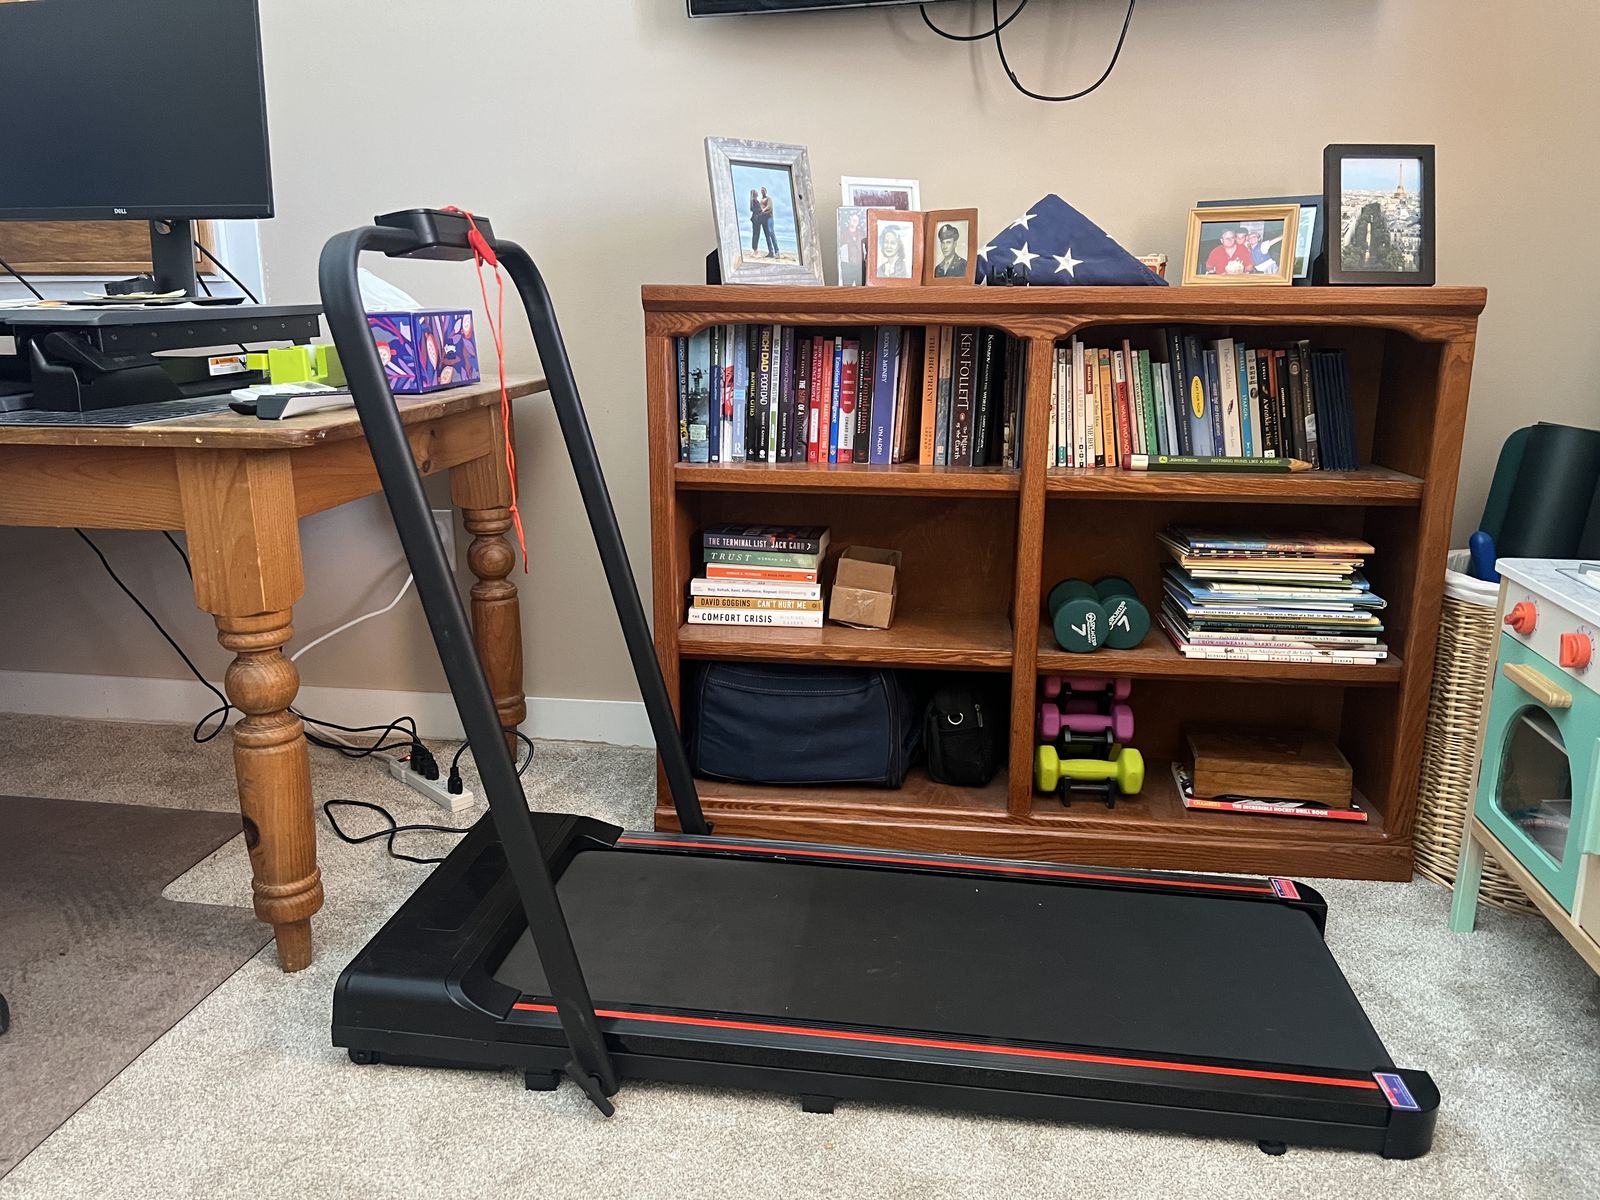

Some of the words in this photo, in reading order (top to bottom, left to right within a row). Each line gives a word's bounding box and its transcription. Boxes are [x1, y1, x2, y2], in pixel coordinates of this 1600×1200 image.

[961, 333, 973, 356] KEN
[761, 352, 769, 372] DAD
[760, 374, 768, 391] POOR
[958, 360, 971, 410] FOLLETT
[760, 392, 768, 405] DAD
[861, 378, 871, 434] Foundations
[1103, 384, 1111, 411] Becoming
[1264, 404, 1272, 426] Wrinkle
[708, 537, 720, 545] THE
[723, 538, 752, 547] TERMINAL
[753, 540, 767, 548] LIST
[771, 541, 787, 549] JACK
[789, 542, 805, 550] CARR
[711, 552, 752, 561] TRUST
[701, 598, 720, 607] DAVID
[722, 599, 750, 607] GOGGINS
[757, 600, 776, 608] CAN'T
[778, 601, 794, 609] HURT
[796, 601, 807, 609] ME
[702, 613, 740, 622] COMFORT
[744, 614, 772, 623] CRISIS
[1243, 804, 1273, 812] INCREDIBLE
